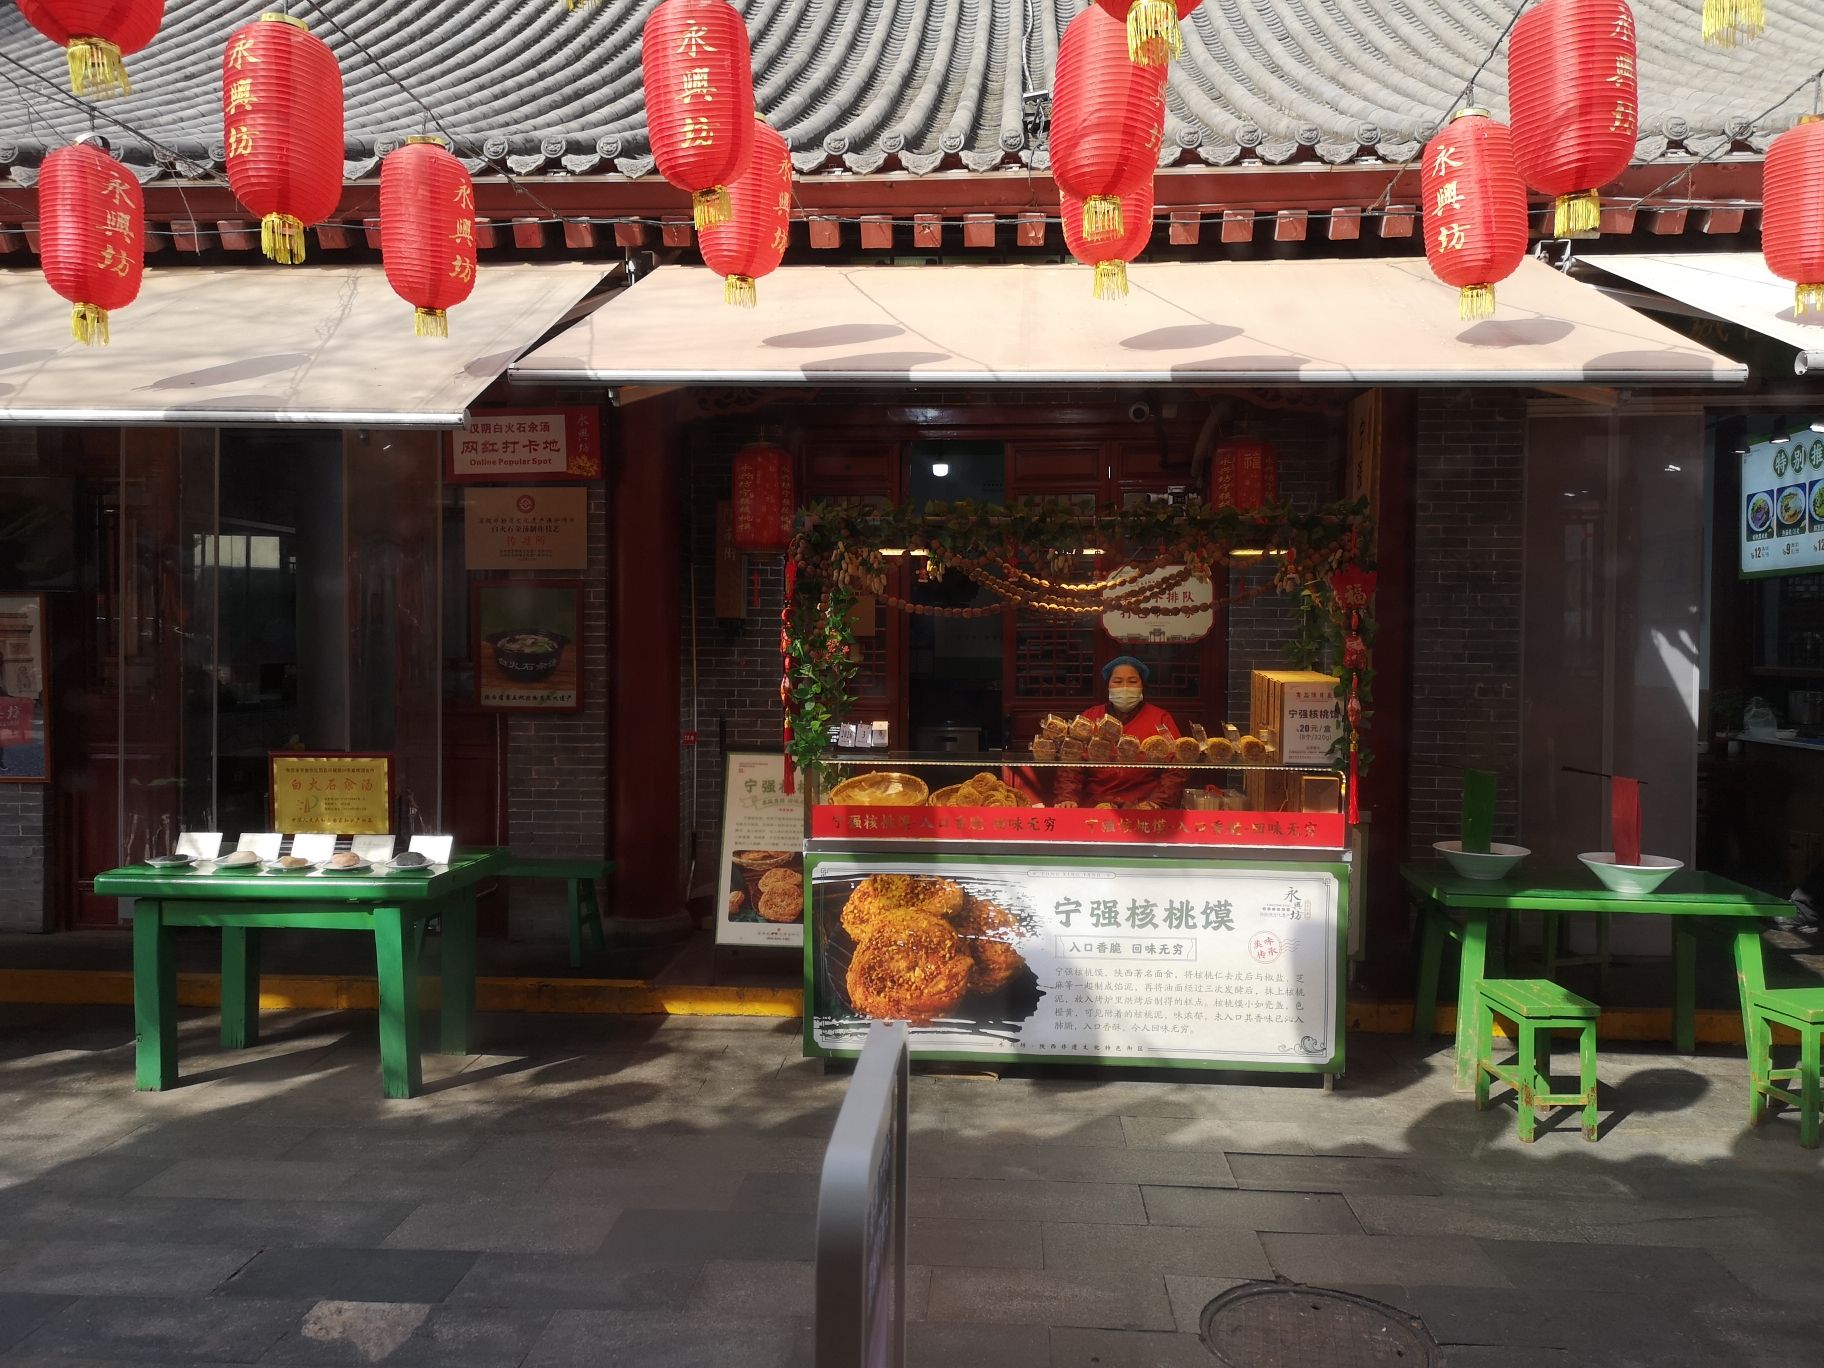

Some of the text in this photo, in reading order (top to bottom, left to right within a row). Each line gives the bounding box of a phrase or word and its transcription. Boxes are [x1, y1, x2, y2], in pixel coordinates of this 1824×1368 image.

[225, 34, 262, 158] 永興坊
[675, 20, 720, 148] 永興坊
[96, 171, 136, 277] 永興坊
[449, 177, 474, 282] 永興坊
[1432, 145, 1470, 253] 永興坊
[461, 439, 561, 455] 网红打卡地
[470, 457, 552, 467] Online Popular Spot
[1345, 584, 1367, 605] 福
[1054, 896, 1236, 931] 宁强核桃馍
[1069, 942, 1184, 955] 入口香脆 回味无穷
